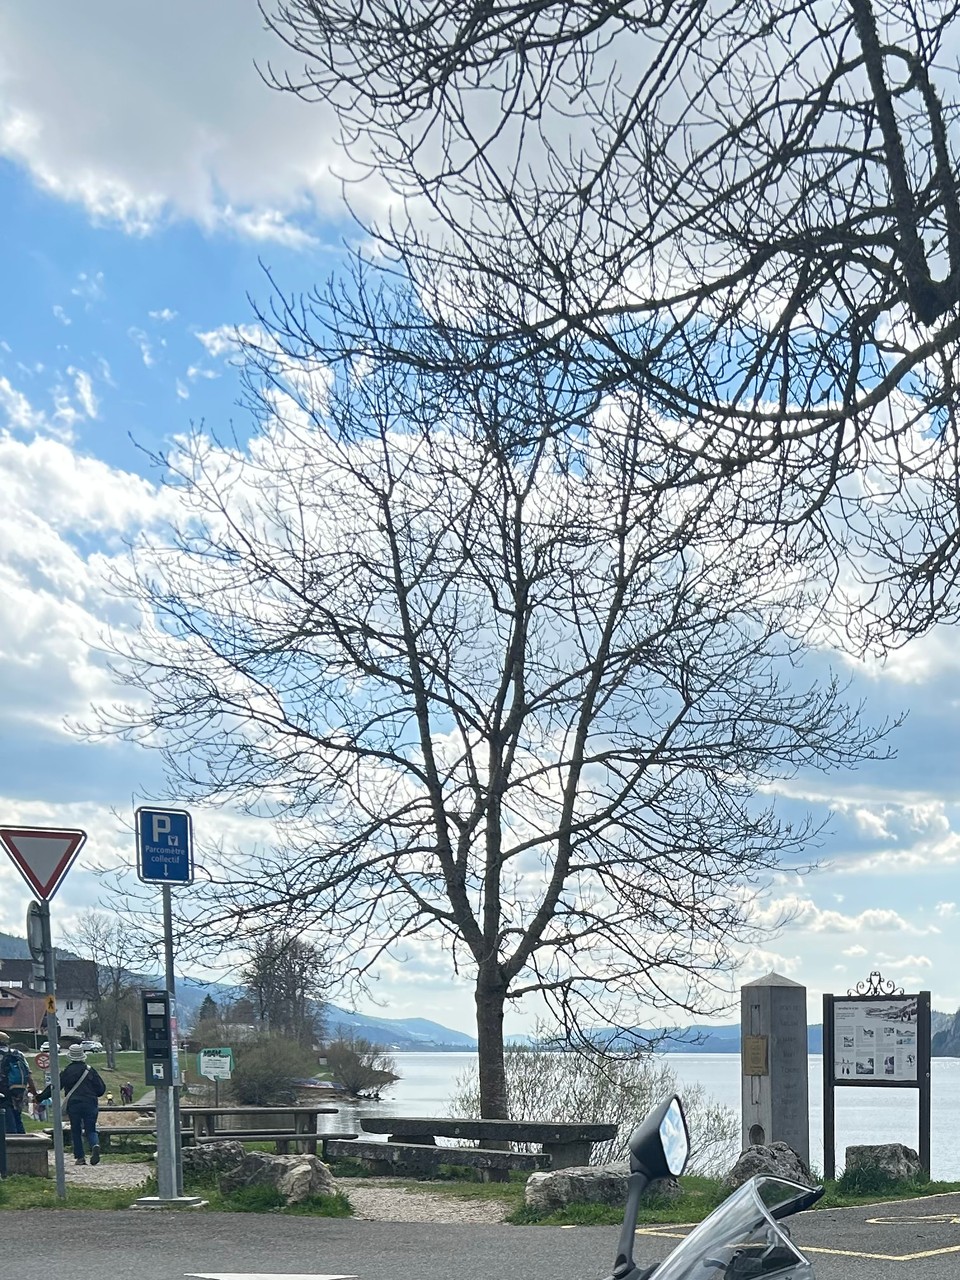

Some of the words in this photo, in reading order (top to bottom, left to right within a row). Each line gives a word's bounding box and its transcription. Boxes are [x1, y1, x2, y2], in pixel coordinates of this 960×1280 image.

[152, 815, 171, 842] P
[145, 845, 186, 856] Parcomètre
[151, 856, 180, 864] collectif
